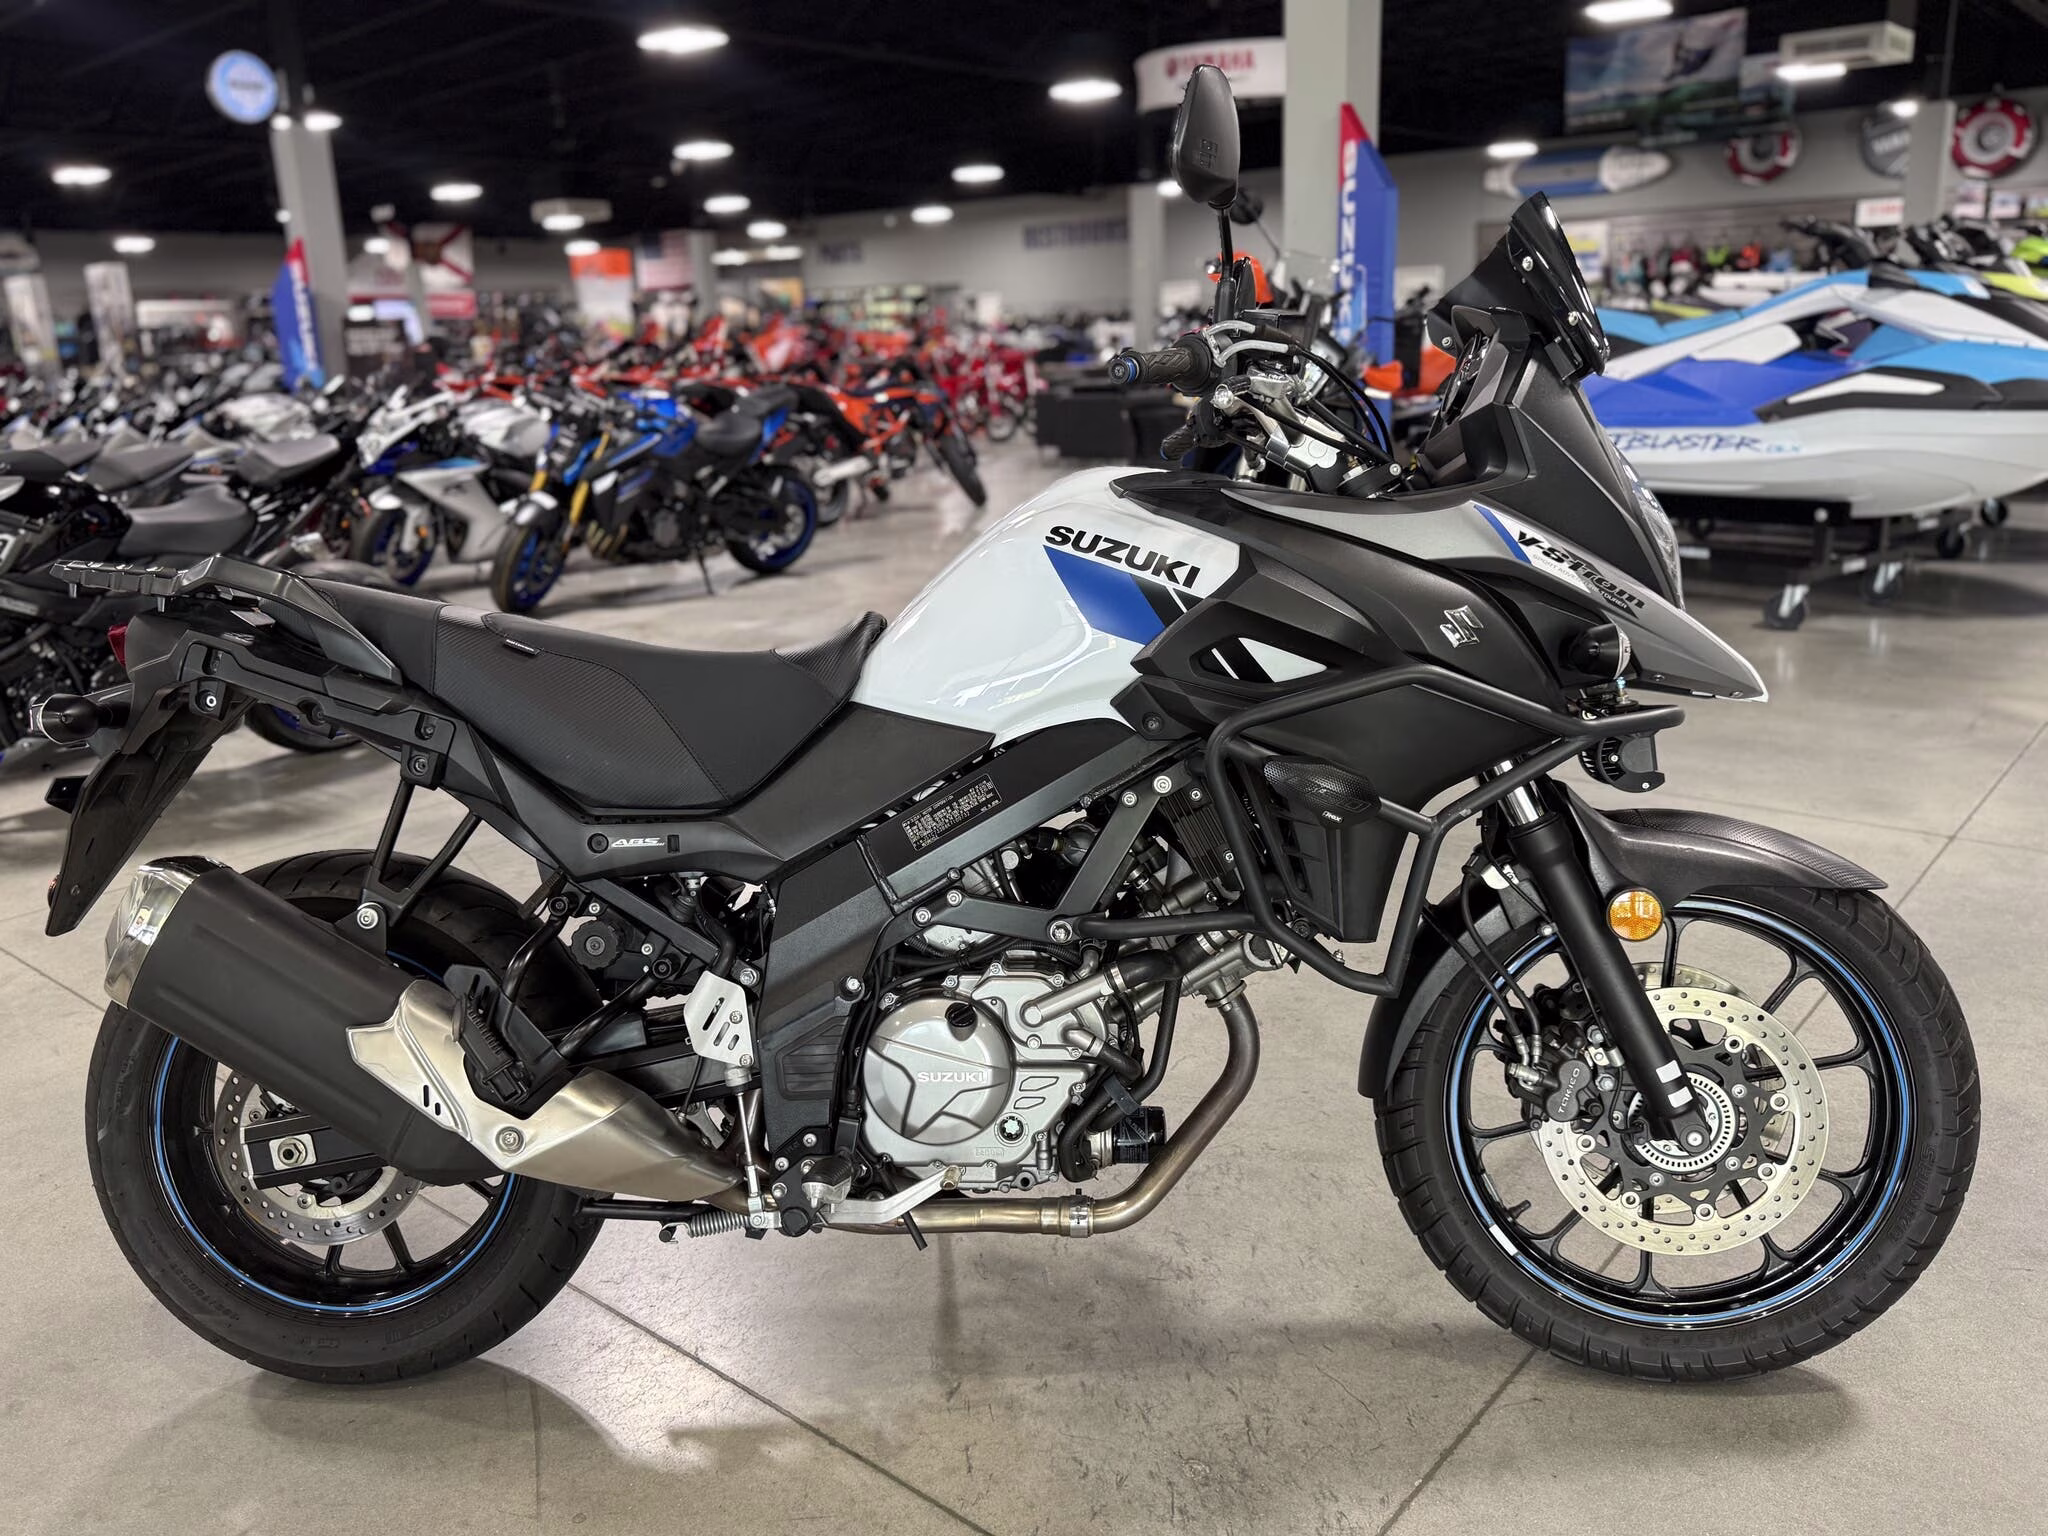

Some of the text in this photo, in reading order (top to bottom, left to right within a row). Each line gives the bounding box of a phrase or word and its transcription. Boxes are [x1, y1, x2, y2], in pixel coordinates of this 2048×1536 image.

[1337, 138, 1359, 342] SUZUKI
[1045, 525, 1200, 589] SUZUKI
[1600, 590, 1628, 610] TOURER
[611, 837, 662, 848] ABS
[917, 1071, 986, 1084] SUZUKI
[1557, 1067, 1580, 1113] TOKICO
